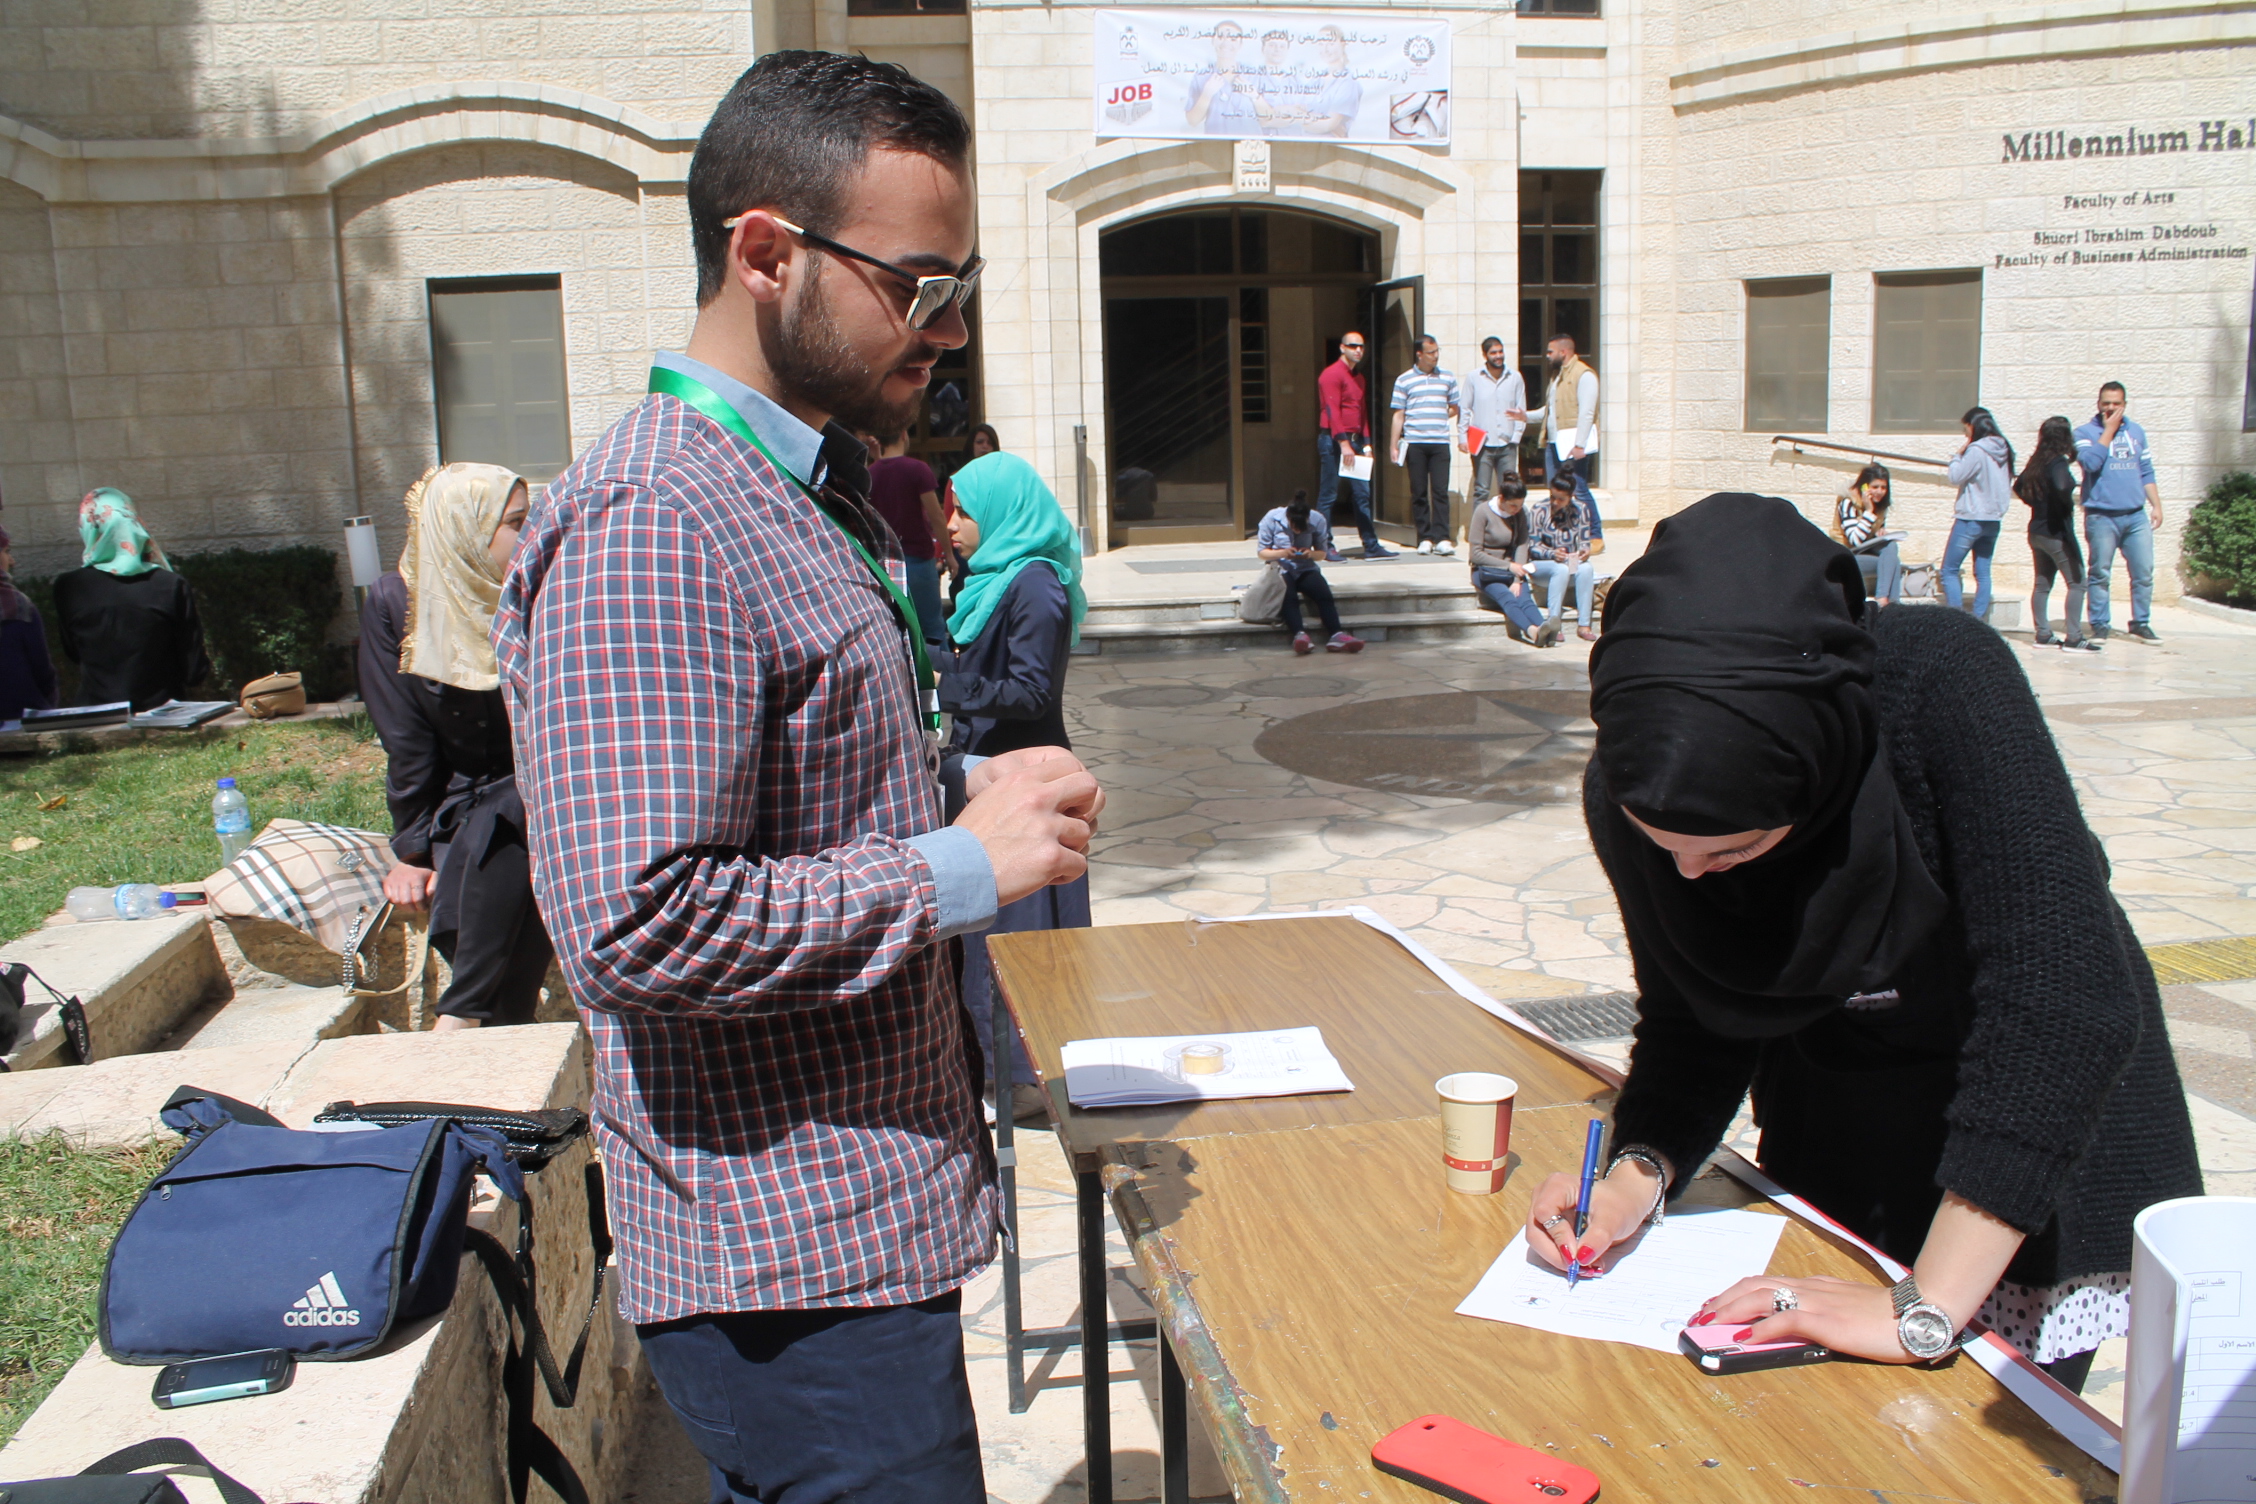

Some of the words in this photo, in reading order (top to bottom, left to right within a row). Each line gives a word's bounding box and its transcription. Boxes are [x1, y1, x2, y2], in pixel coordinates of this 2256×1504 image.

[1163, 26, 1189, 41] الكريم
[1298, 30, 1337, 45] التمريض
[1351, 69, 1375, 80] العمل
[1107, 83, 1153, 105] JOB
[1232, 84, 1254, 94] 2015
[1283, 85, 1293, 94] 21
[2001, 127, 2189, 163] Millennium
[2063, 193, 2117, 209] Faculty
[2122, 191, 2138, 206] of
[2142, 191, 2175, 205] Arts
[2033, 230, 2079, 245] Shucri
[2084, 228, 2144, 243] Ibrahim
[2152, 223, 2218, 240] Dabdoub
[1995, 252, 2049, 270] Faculty
[2053, 251, 2069, 265] of
[2072, 250, 2134, 266] Business
[2137, 245, 2249, 262] Administration
[283, 1307, 361, 1328] adidas
